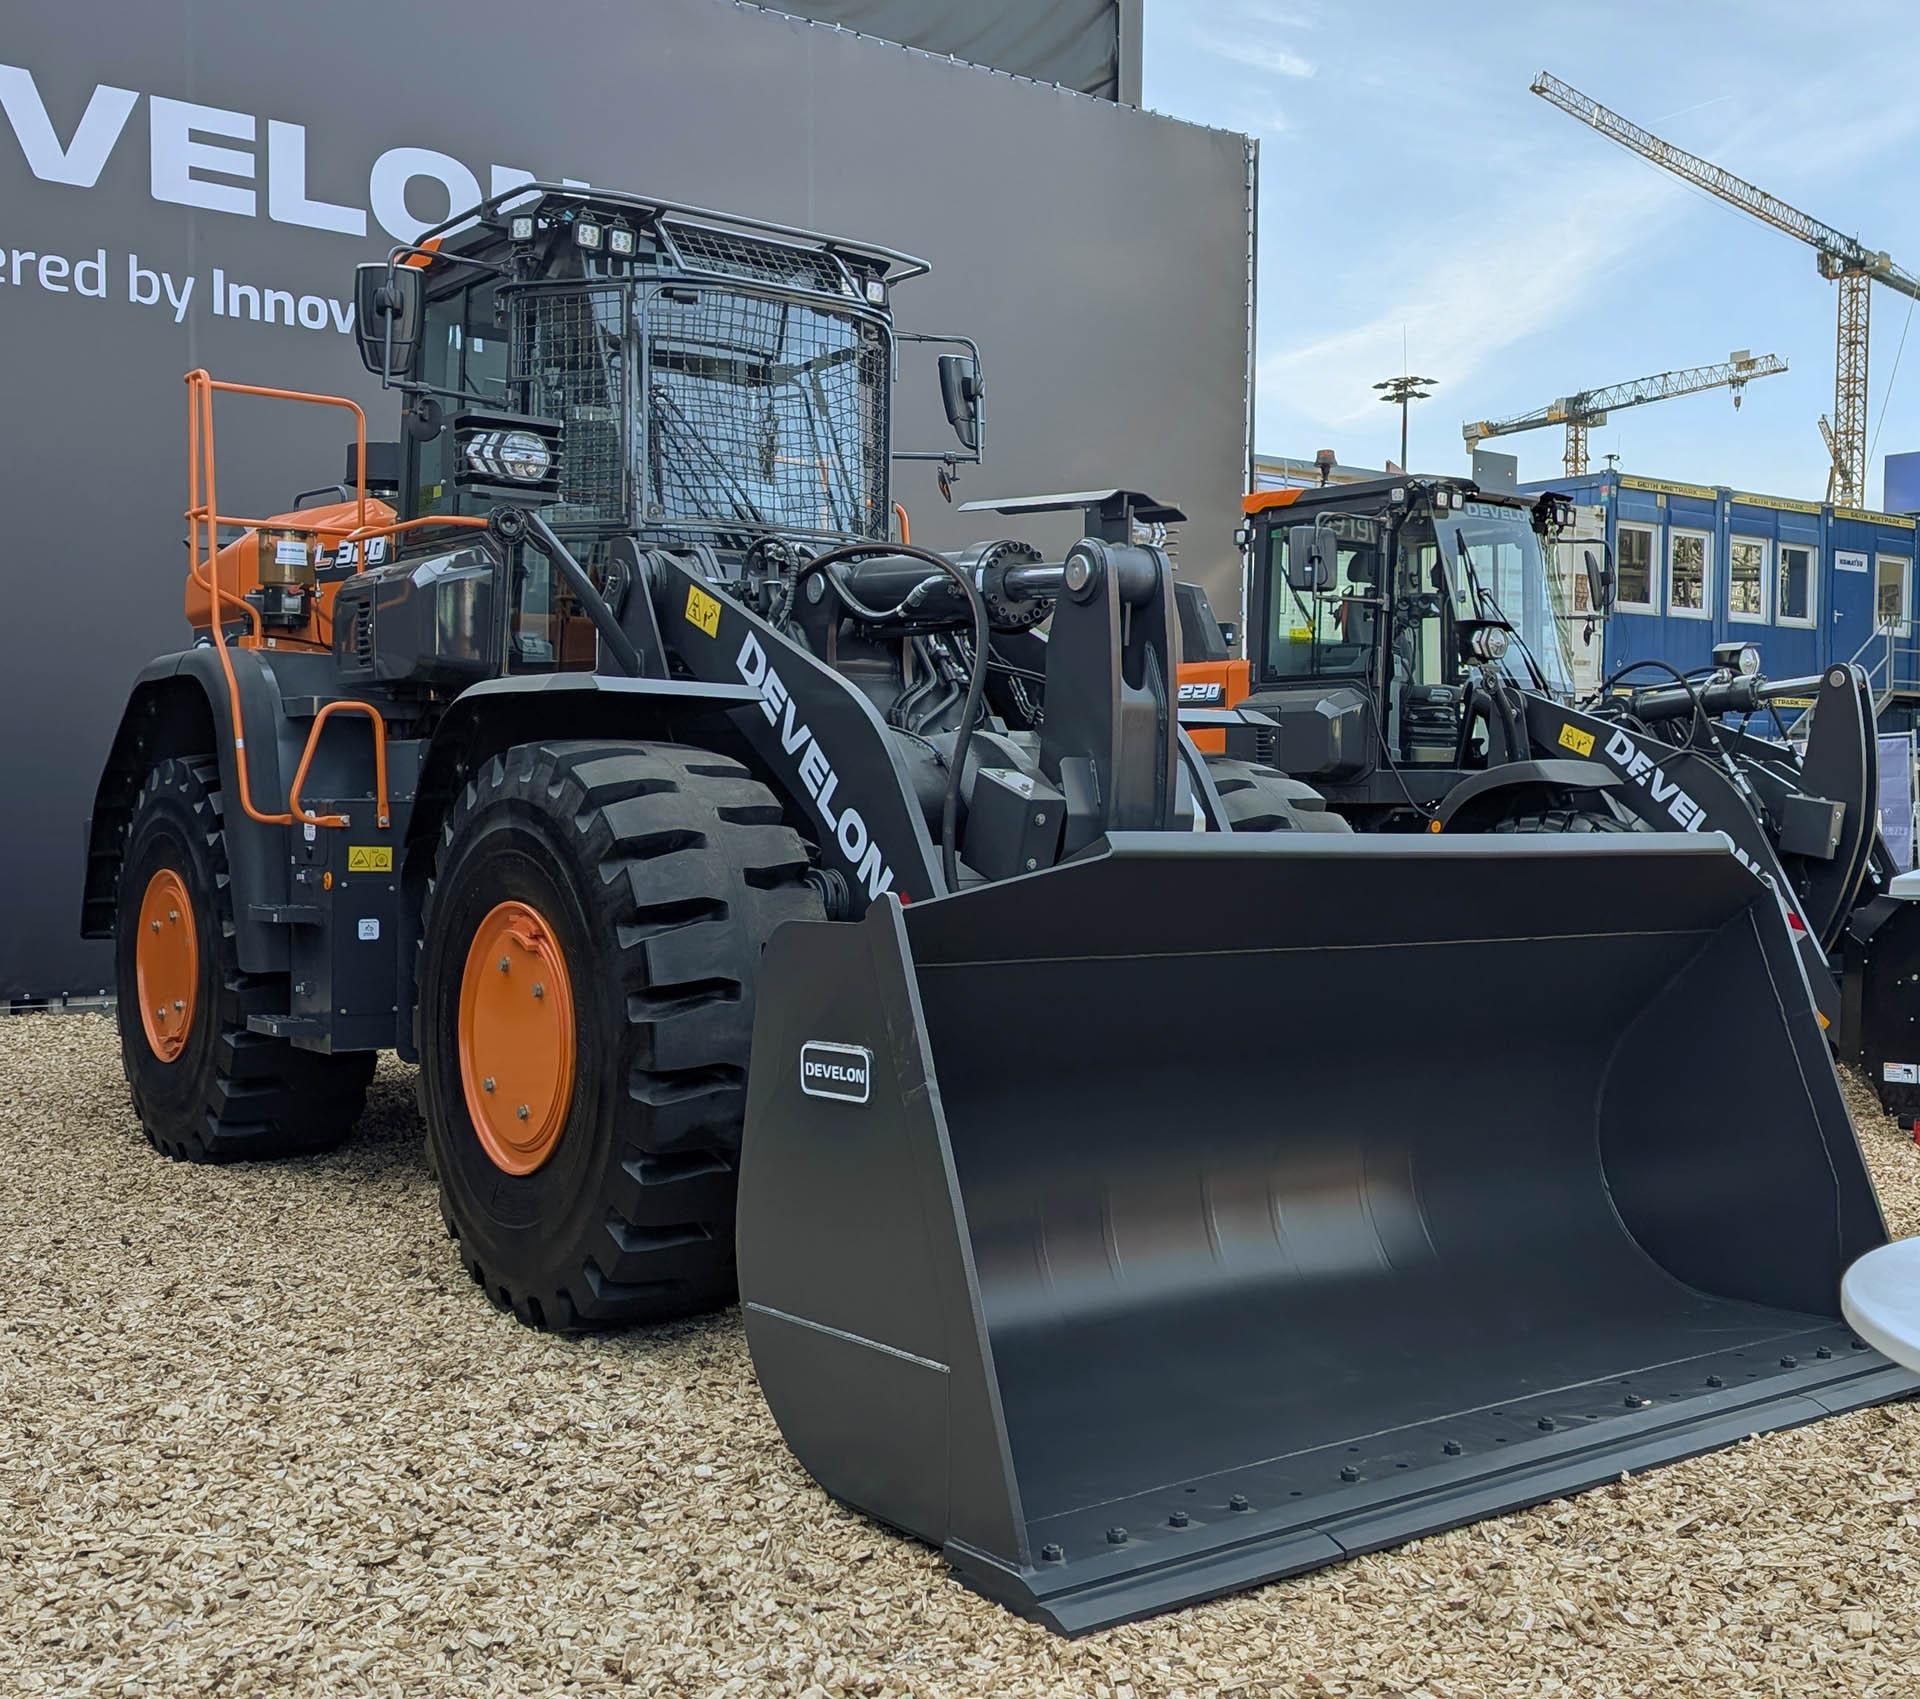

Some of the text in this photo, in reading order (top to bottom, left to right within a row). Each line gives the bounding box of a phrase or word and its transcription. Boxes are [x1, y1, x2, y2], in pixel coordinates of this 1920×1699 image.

[0, 248, 106, 297] red
[128, 254, 194, 323] by
[1661, 483, 1698, 496] MIETPARK
[1178, 683, 1221, 701] 220
[736, 630, 894, 901] DEVELON
[1604, 729, 1761, 874] DEVEL
[805, 1062, 865, 1084] DEVELON
